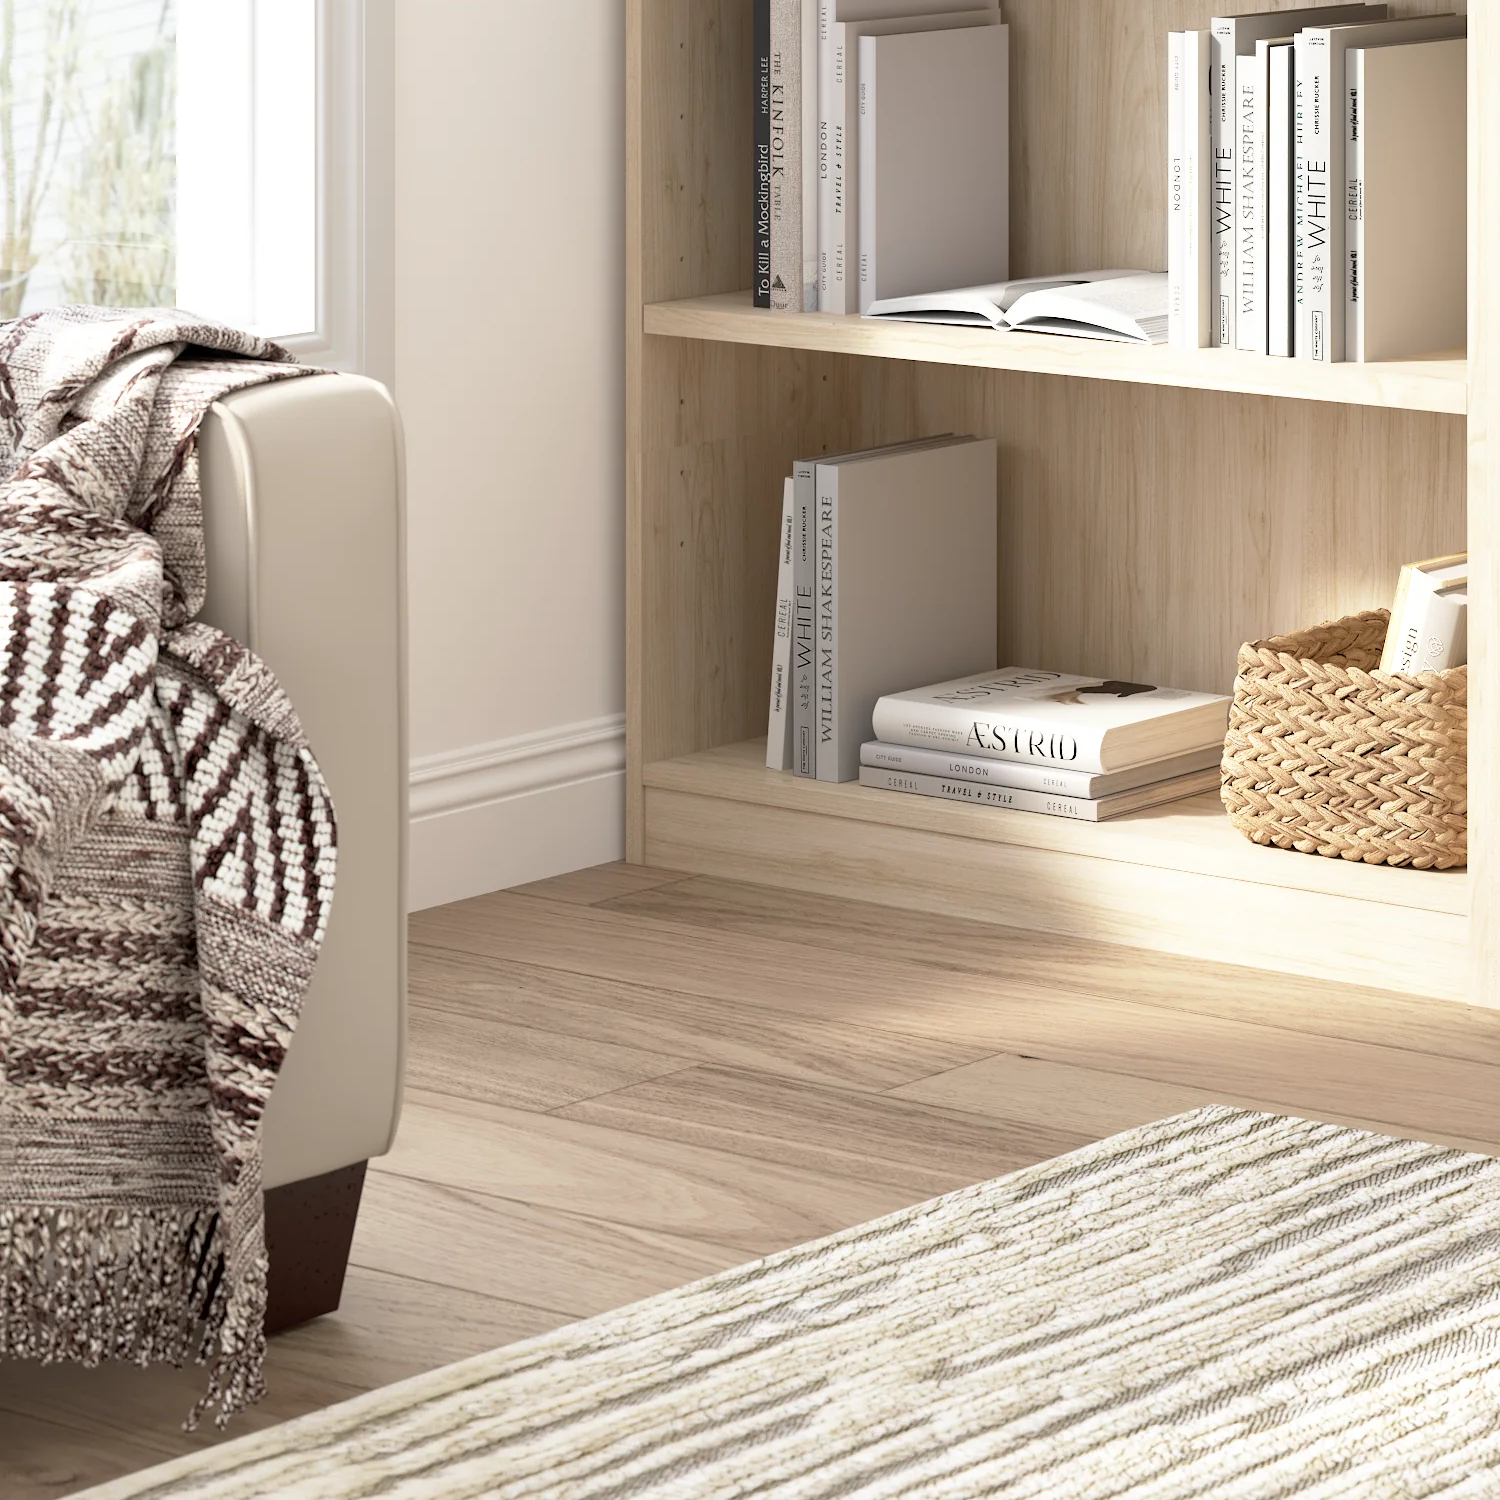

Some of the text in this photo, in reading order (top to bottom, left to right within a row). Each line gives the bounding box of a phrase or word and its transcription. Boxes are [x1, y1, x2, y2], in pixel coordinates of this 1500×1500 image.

[760, 76, 768, 114] HARPER
[772, 84, 784, 178] KINFOLK
[820, 121, 828, 179] LONDON
[1173, 158, 1181, 211] LONDON
[1215, 148, 1232, 234] WHITE
[1242, 85, 1254, 314] WILLIAM SHAKESPEARE
[1308, 160, 1326, 249] WHITE
[1349, 179, 1358, 220] CEREAL
[758, 144, 770, 296] To Kill Mockingbird
[778, 598, 788, 638] CEREAL
[796, 586, 812, 668] WHITE
[820, 496, 832, 744] WILLIAM SHAKESPEARE
[950, 764, 988, 776] LONDON
[966, 722, 1078, 760] ÆSTRID
[887, 774, 1078, 815] CEREAL TRAVEL STYLE CEREAL
